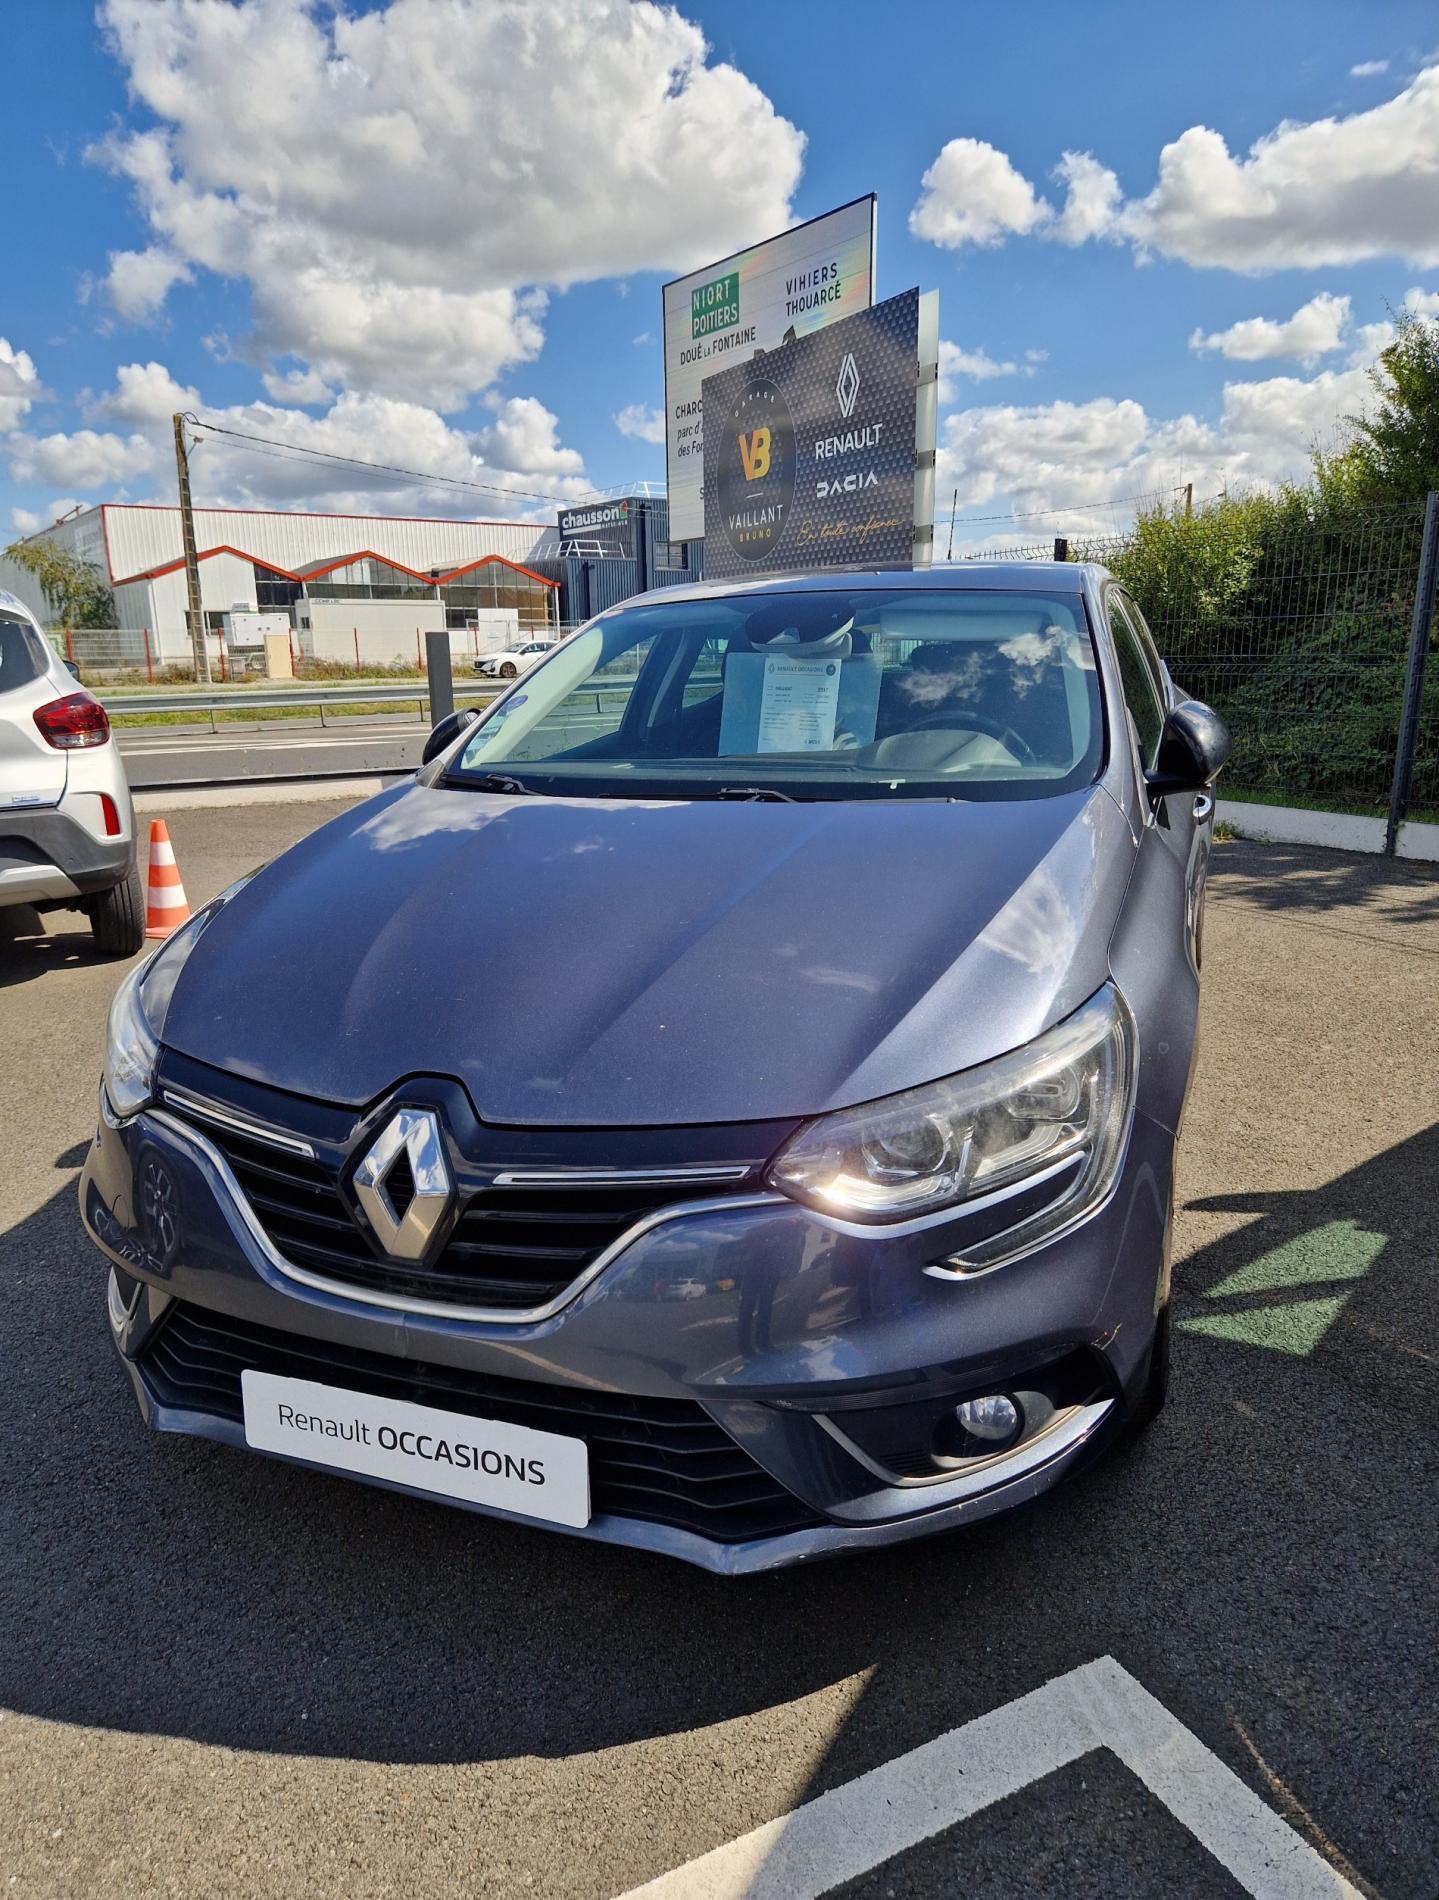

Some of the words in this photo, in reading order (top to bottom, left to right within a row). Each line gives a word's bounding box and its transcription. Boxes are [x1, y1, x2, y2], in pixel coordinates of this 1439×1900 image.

[693, 279, 731, 311] NIORT
[786, 262, 838, 296] VIHIERS
[785, 280, 841, 317] THOUARCÉ
[693, 303, 738, 336] POITIERS
[680, 343, 703, 366] DOUÉ
[712, 326, 756, 355] FONTAINE
[677, 425, 693, 442] parc
[677, 442, 690, 457] des
[815, 423, 883, 460] RENAULT
[738, 427, 771, 481] VB
[816, 471, 879, 498] DACIA
[562, 507, 619, 529] chausson
[728, 504, 784, 530] VAILLANT
[739, 528, 771, 543] BRUNO
[278, 1404, 371, 1446] Renault
[378, 1426, 546, 1486] OCCASIONS
